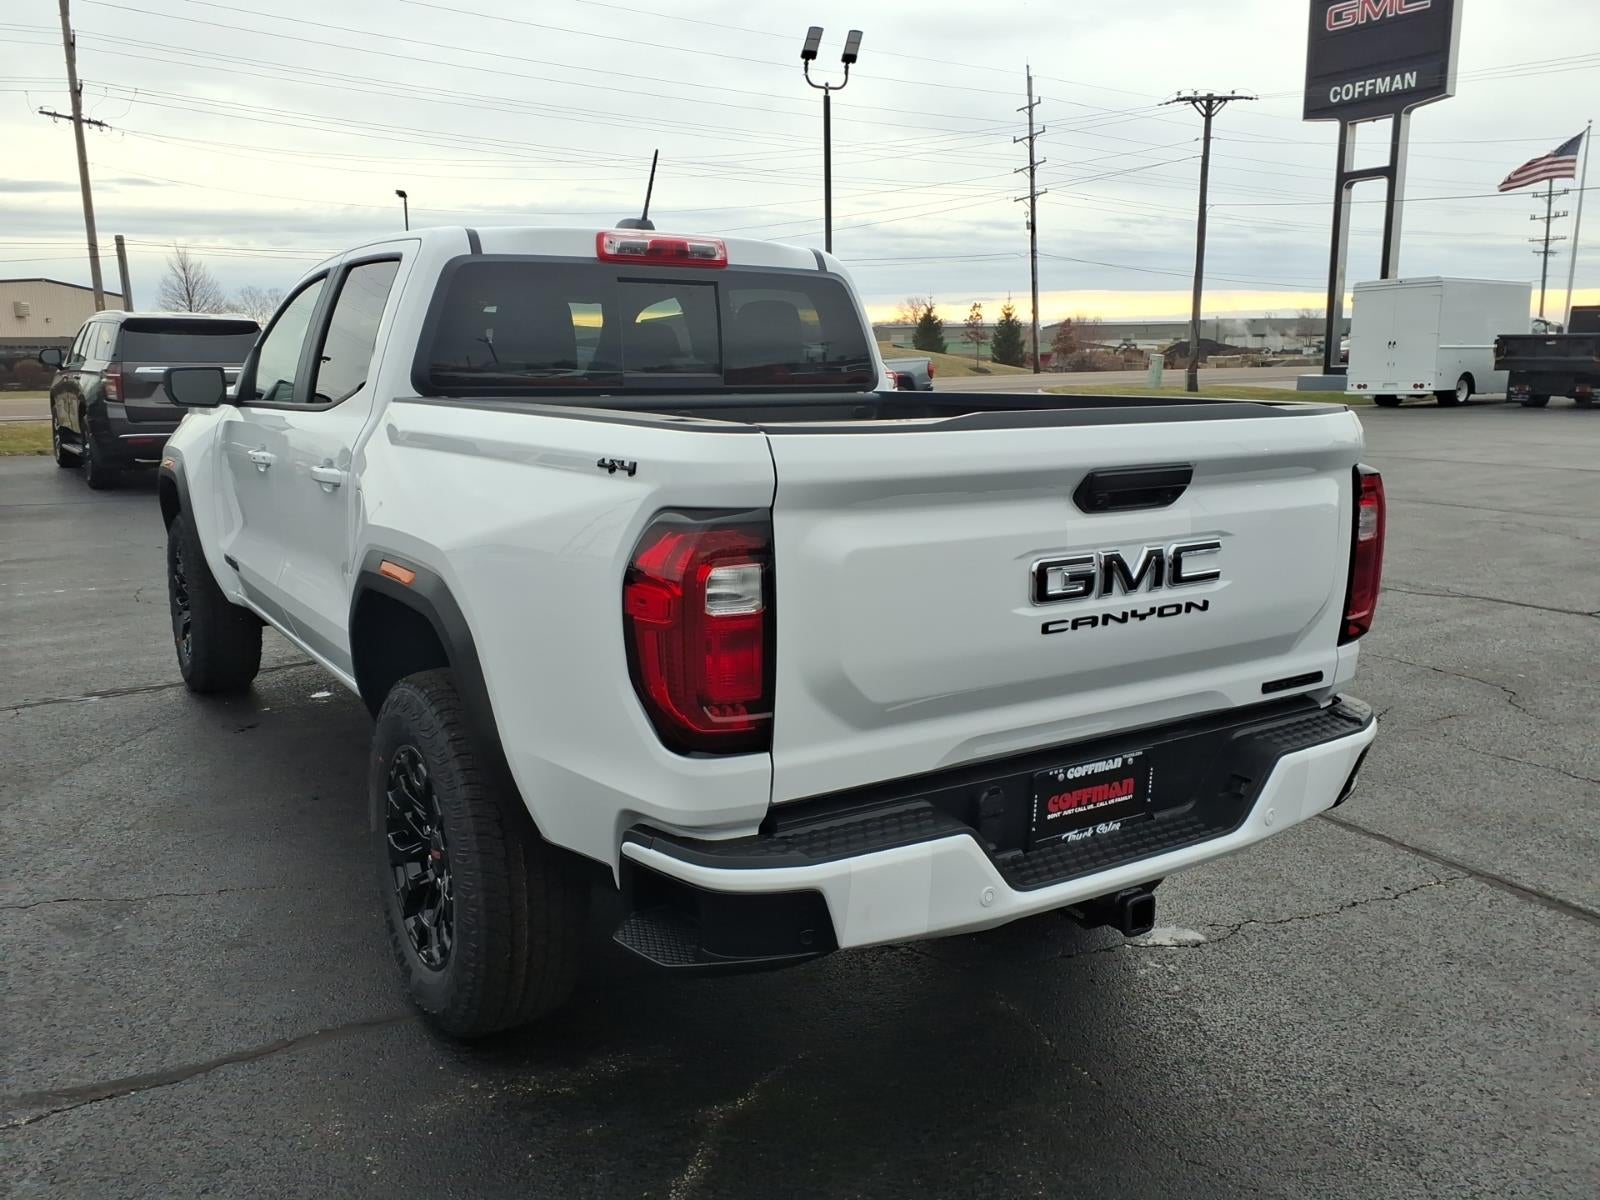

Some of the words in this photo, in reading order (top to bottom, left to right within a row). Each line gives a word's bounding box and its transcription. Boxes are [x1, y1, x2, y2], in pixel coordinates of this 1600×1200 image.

[1329, 71, 1417, 103] COFFMAN
[1029, 538, 1222, 607] GMC
[1041, 599, 1209, 635] CANYON
[1066, 757, 1122, 779] COFFMAN
[1048, 778, 1134, 813] COFFMAN
[1062, 808, 1075, 816] JUST
[1074, 804, 1087, 813] CALL
[1061, 826, 1094, 842] Truck
[1096, 821, 1121, 834] Sales
